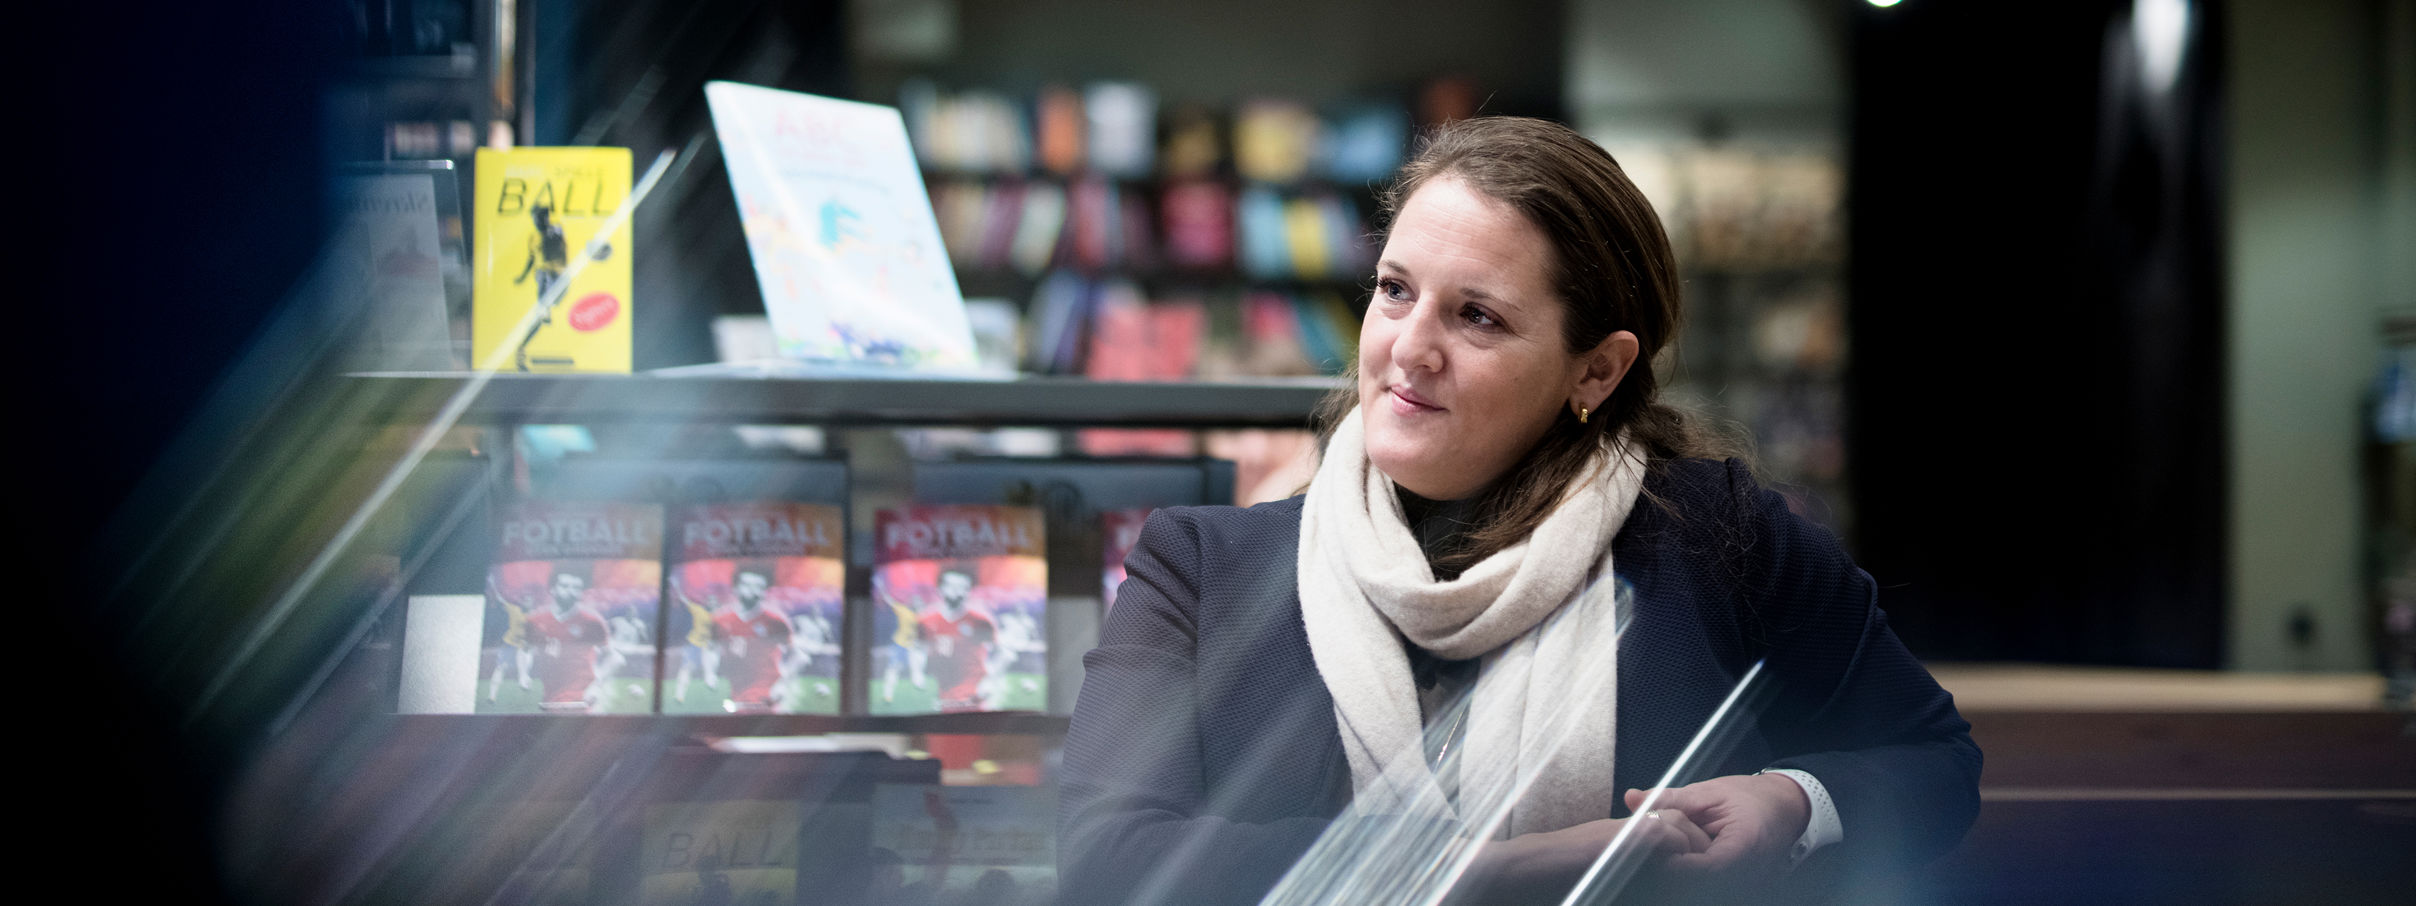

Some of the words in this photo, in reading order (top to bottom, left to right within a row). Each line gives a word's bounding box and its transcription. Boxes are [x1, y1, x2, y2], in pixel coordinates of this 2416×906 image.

[497, 177, 615, 217] BALL
[503, 517, 651, 547] FOTBALL
[683, 517, 832, 549] FOTBALL
[885, 517, 1030, 550] FOTBALL
[662, 832, 785, 870] BALL
